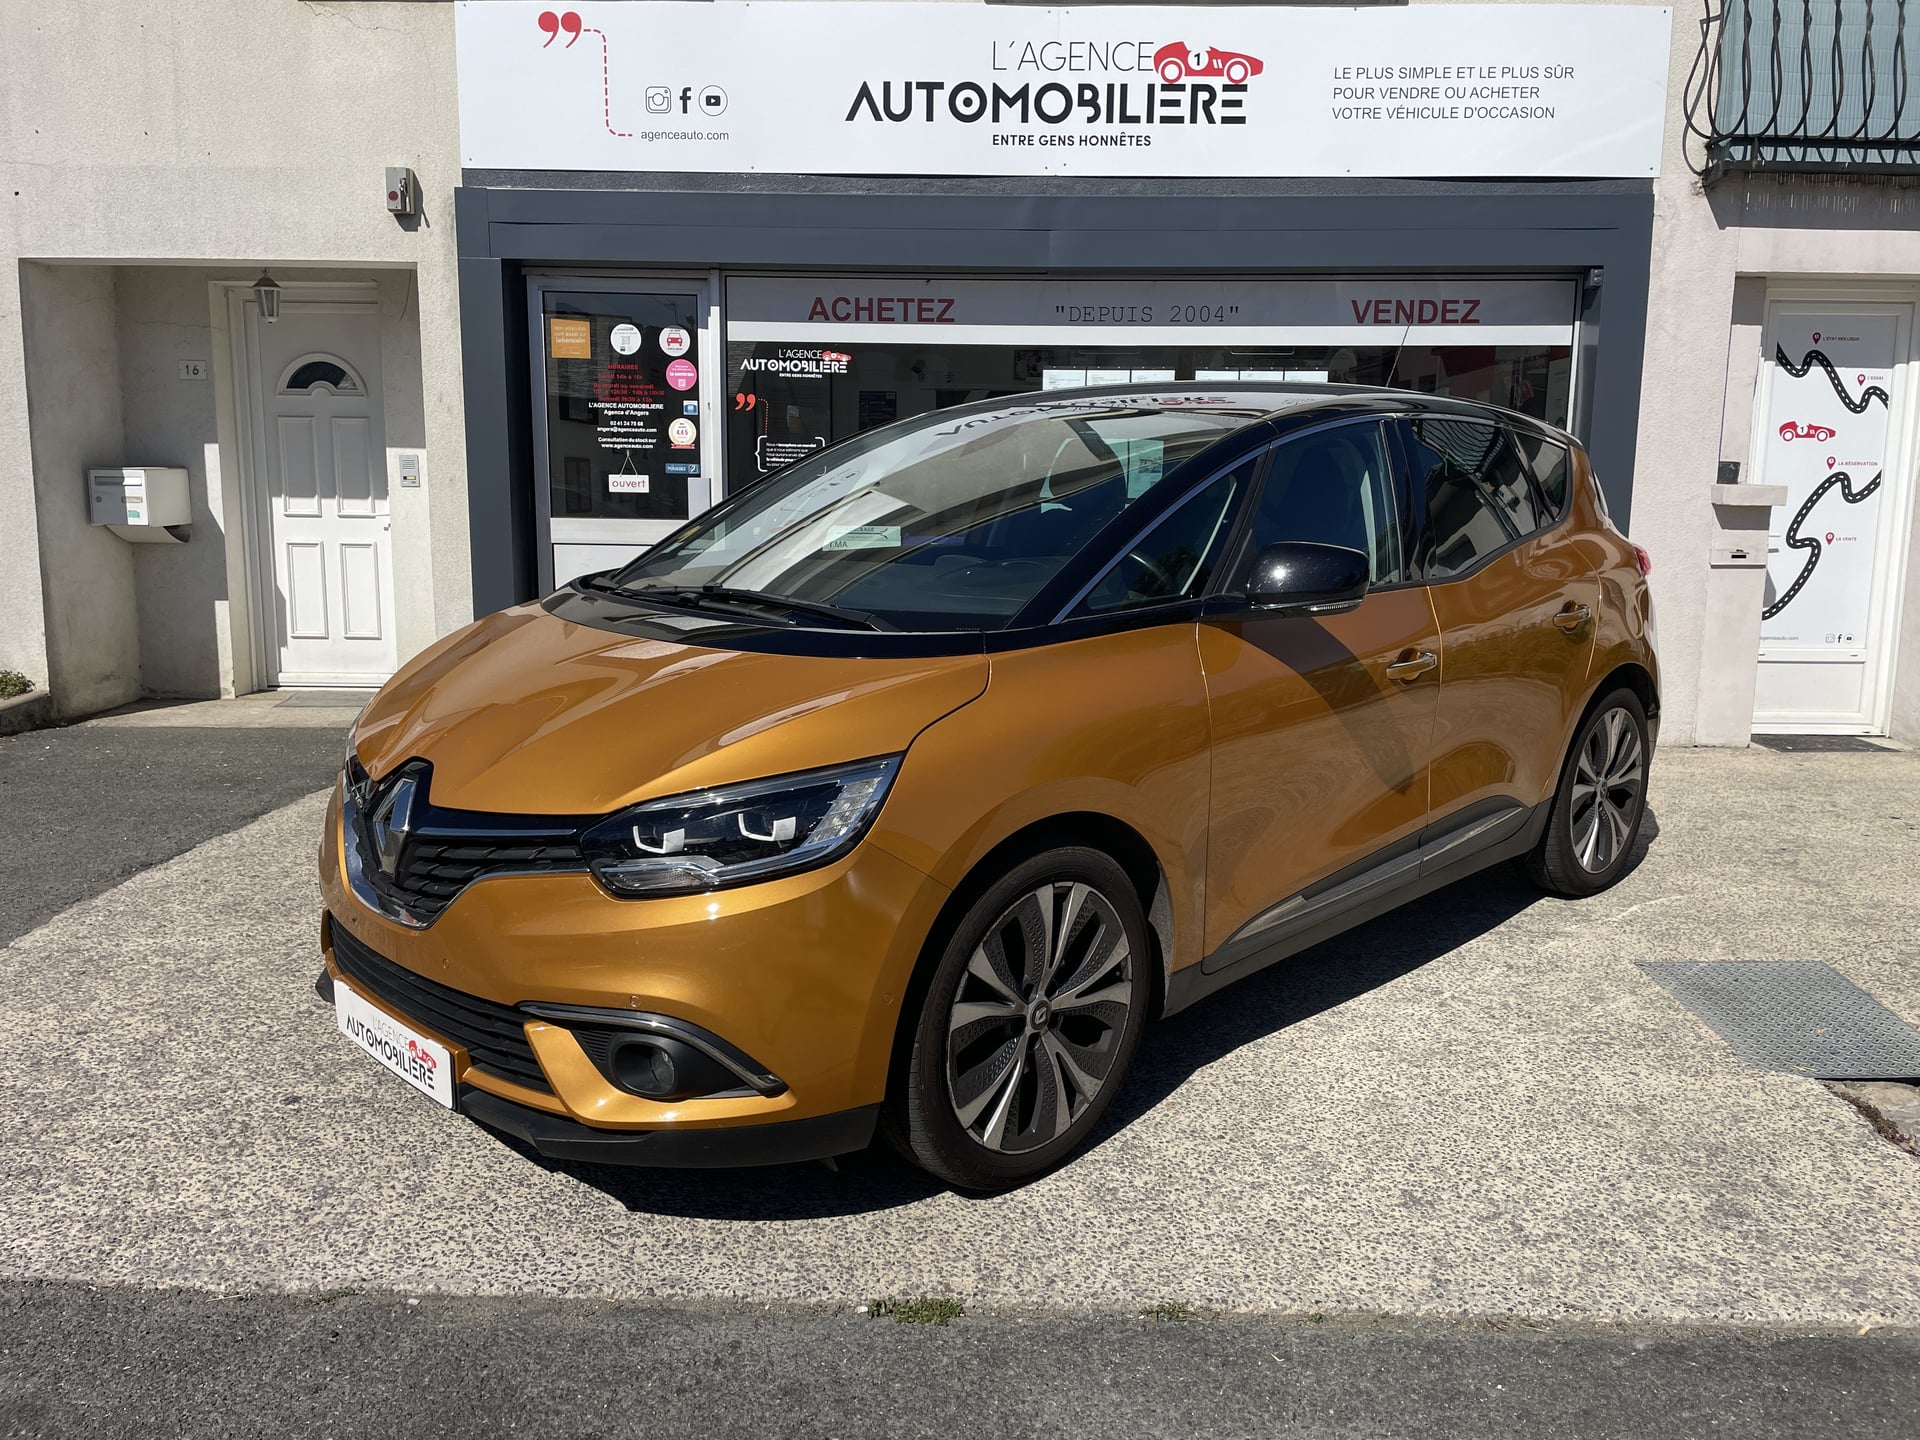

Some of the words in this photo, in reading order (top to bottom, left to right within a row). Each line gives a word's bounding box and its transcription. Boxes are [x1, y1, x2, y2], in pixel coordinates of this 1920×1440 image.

[992, 40, 1154, 72] L'AGENCE
[1334, 66, 1352, 80] LE
[1356, 66, 1394, 80] PLUS
[1398, 66, 1452, 80] SIMPLE
[1456, 66, 1475, 79] ET
[1479, 66, 1497, 79] LE
[1501, 66, 1540, 79] PLUS
[1543, 64, 1575, 79] SÛR
[1333, 87, 1375, 100] POUR
[1379, 87, 1440, 100] VENDRE
[1444, 86, 1466, 99] OU
[1469, 86, 1540, 99] ACHETER
[1332, 106, 1382, 120] VOTRE
[1386, 104, 1459, 120] VÉHICULE
[1463, 106, 1556, 119] D'OCCASION
[640, 128, 730, 143] agenceauto.com
[992, 134, 1035, 147] ENTRE
[1039, 134, 1075, 147] GENS
[1079, 131, 1152, 147] HONNÊTES
[807, 296, 956, 325] ACHETEZ
[1055, 303, 1154, 325] "DEPUIS
[1168, 304, 1242, 324] 2004"
[1350, 298, 1482, 325] VENDEZ
[779, 349, 822, 359] L'AGENCE
[184, 363, 200, 376] 16
[611, 478, 646, 489] ouvert
[371, 1014, 409, 1051] L'AGENCE
